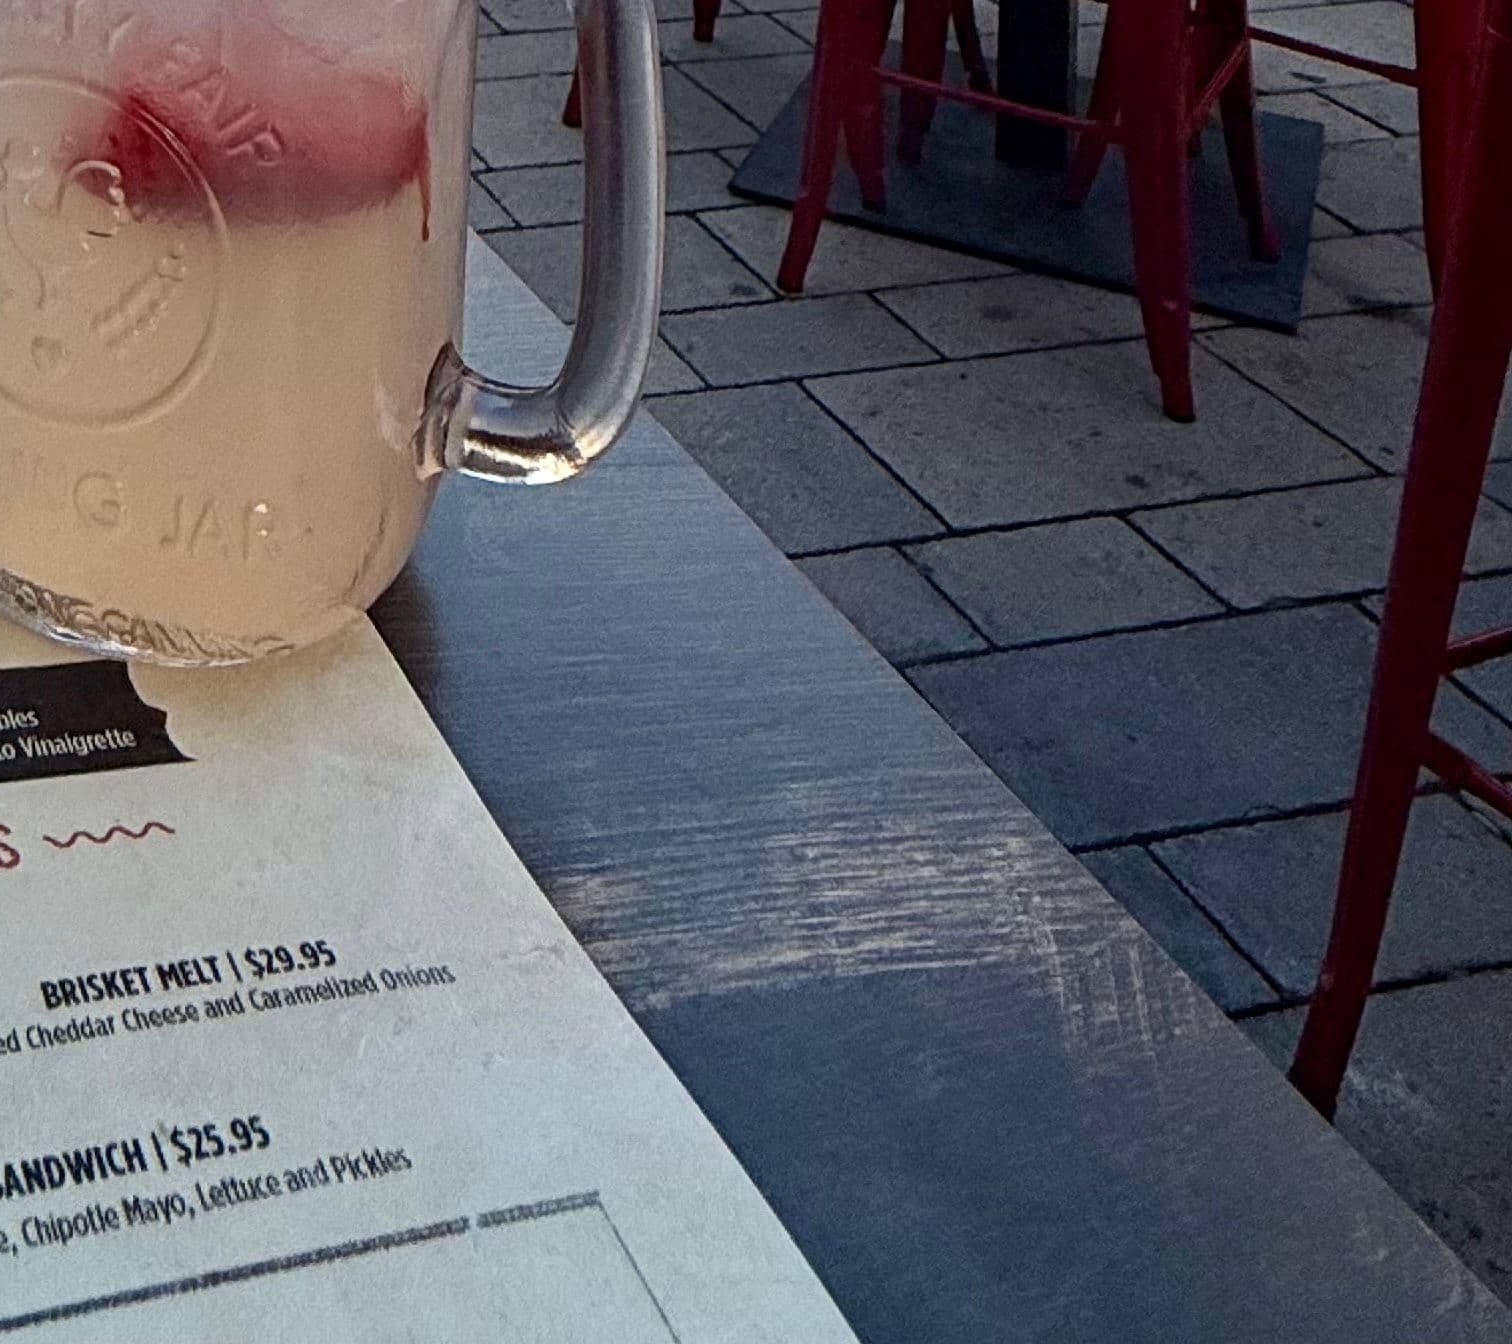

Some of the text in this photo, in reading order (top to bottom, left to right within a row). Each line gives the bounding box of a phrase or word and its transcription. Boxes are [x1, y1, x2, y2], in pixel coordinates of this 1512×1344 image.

[17, 728, 136, 758] Vinaigrette
[25, 1015, 115, 1050] Cheddar
[120, 1003, 199, 1031] Cheese
[203, 992, 245, 1018] and
[247, 971, 379, 1011] Caramelized
[378, 965, 456, 990] Onions
[39, 939, 336, 1010] BRISKET MELT $29.95
[169, 1114, 270, 1167] $25.95
[20, 1203, 120, 1247] Chipotle
[120, 1192, 196, 1226] Mayo,
[194, 1174, 283, 1212] Lettuce
[282, 1158, 330, 1193] and
[328, 1147, 412, 1183] Pickles
